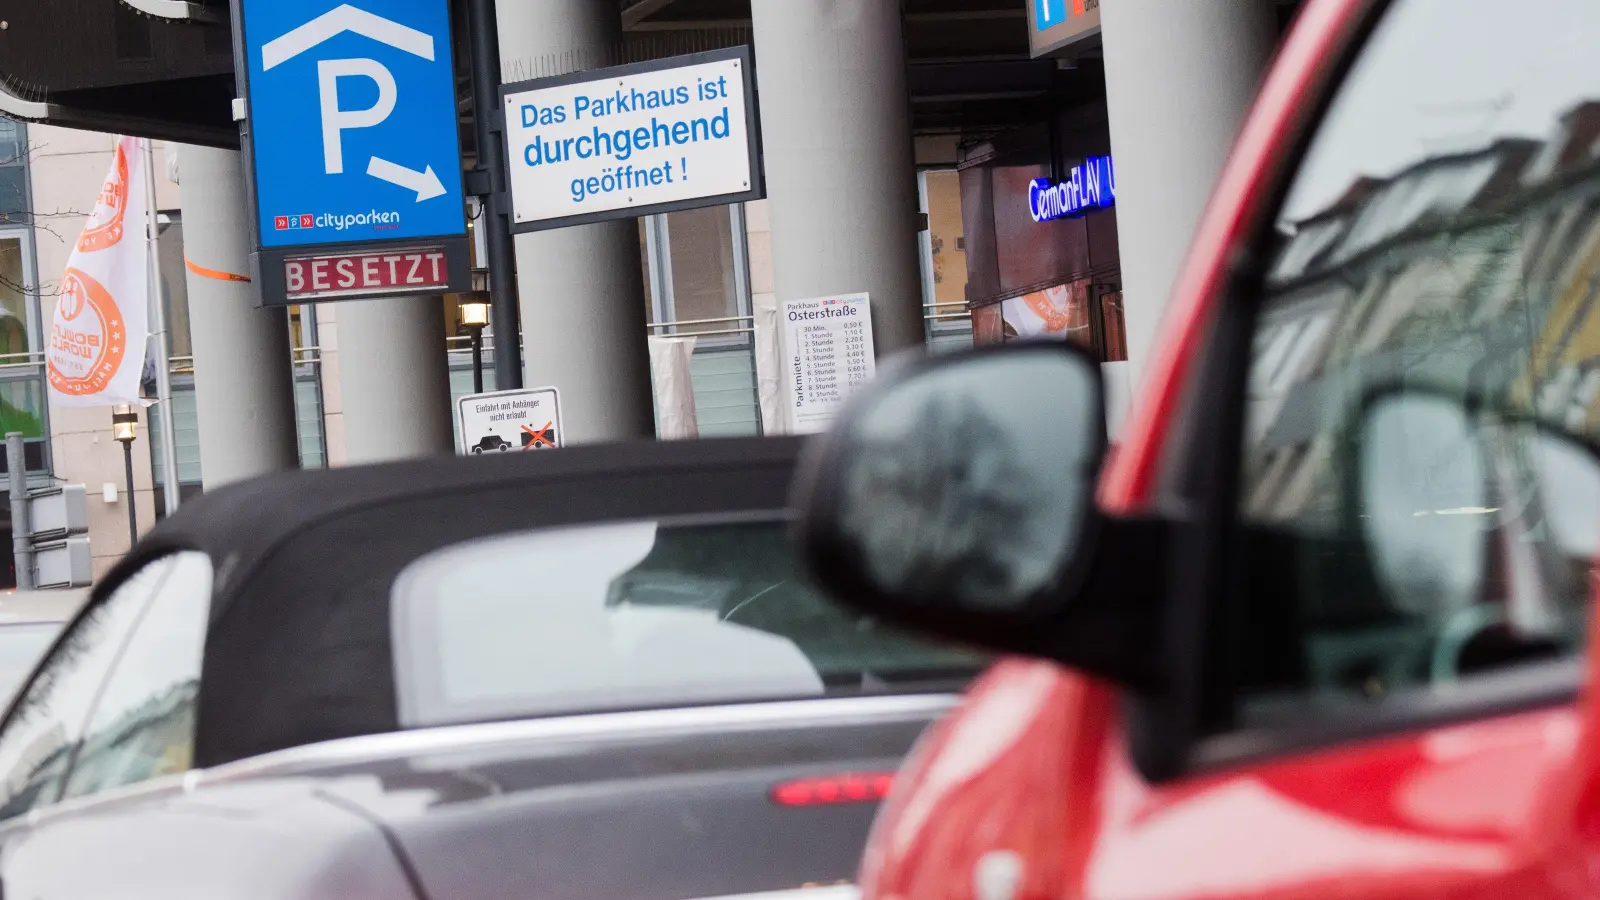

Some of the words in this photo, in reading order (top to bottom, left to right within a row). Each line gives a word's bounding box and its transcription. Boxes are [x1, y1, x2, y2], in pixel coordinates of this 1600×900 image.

[317, 58, 397, 174] P
[521, 104, 566, 128] Das
[574, 86, 690, 120] Parkhaus
[697, 75, 728, 101] ist
[524, 107, 730, 166] durchgehend
[571, 160, 673, 202] geöffnet
[680, 157, 688, 181] !
[315, 209, 400, 231] cityparken
[285, 253, 444, 292] BESETZT
[787, 302, 819, 310] Parkhaus
[788, 305, 857, 321] Osterstraße
[811, 339, 834, 347] Stunde
[794, 356, 804, 407] Parkmiete
[476, 403, 499, 413] Einfahrt
[500, 402, 511, 410] mit
[512, 400, 539, 409] Anhänger
[490, 413, 505, 421] nicht
[507, 411, 526, 420] erlaubt
